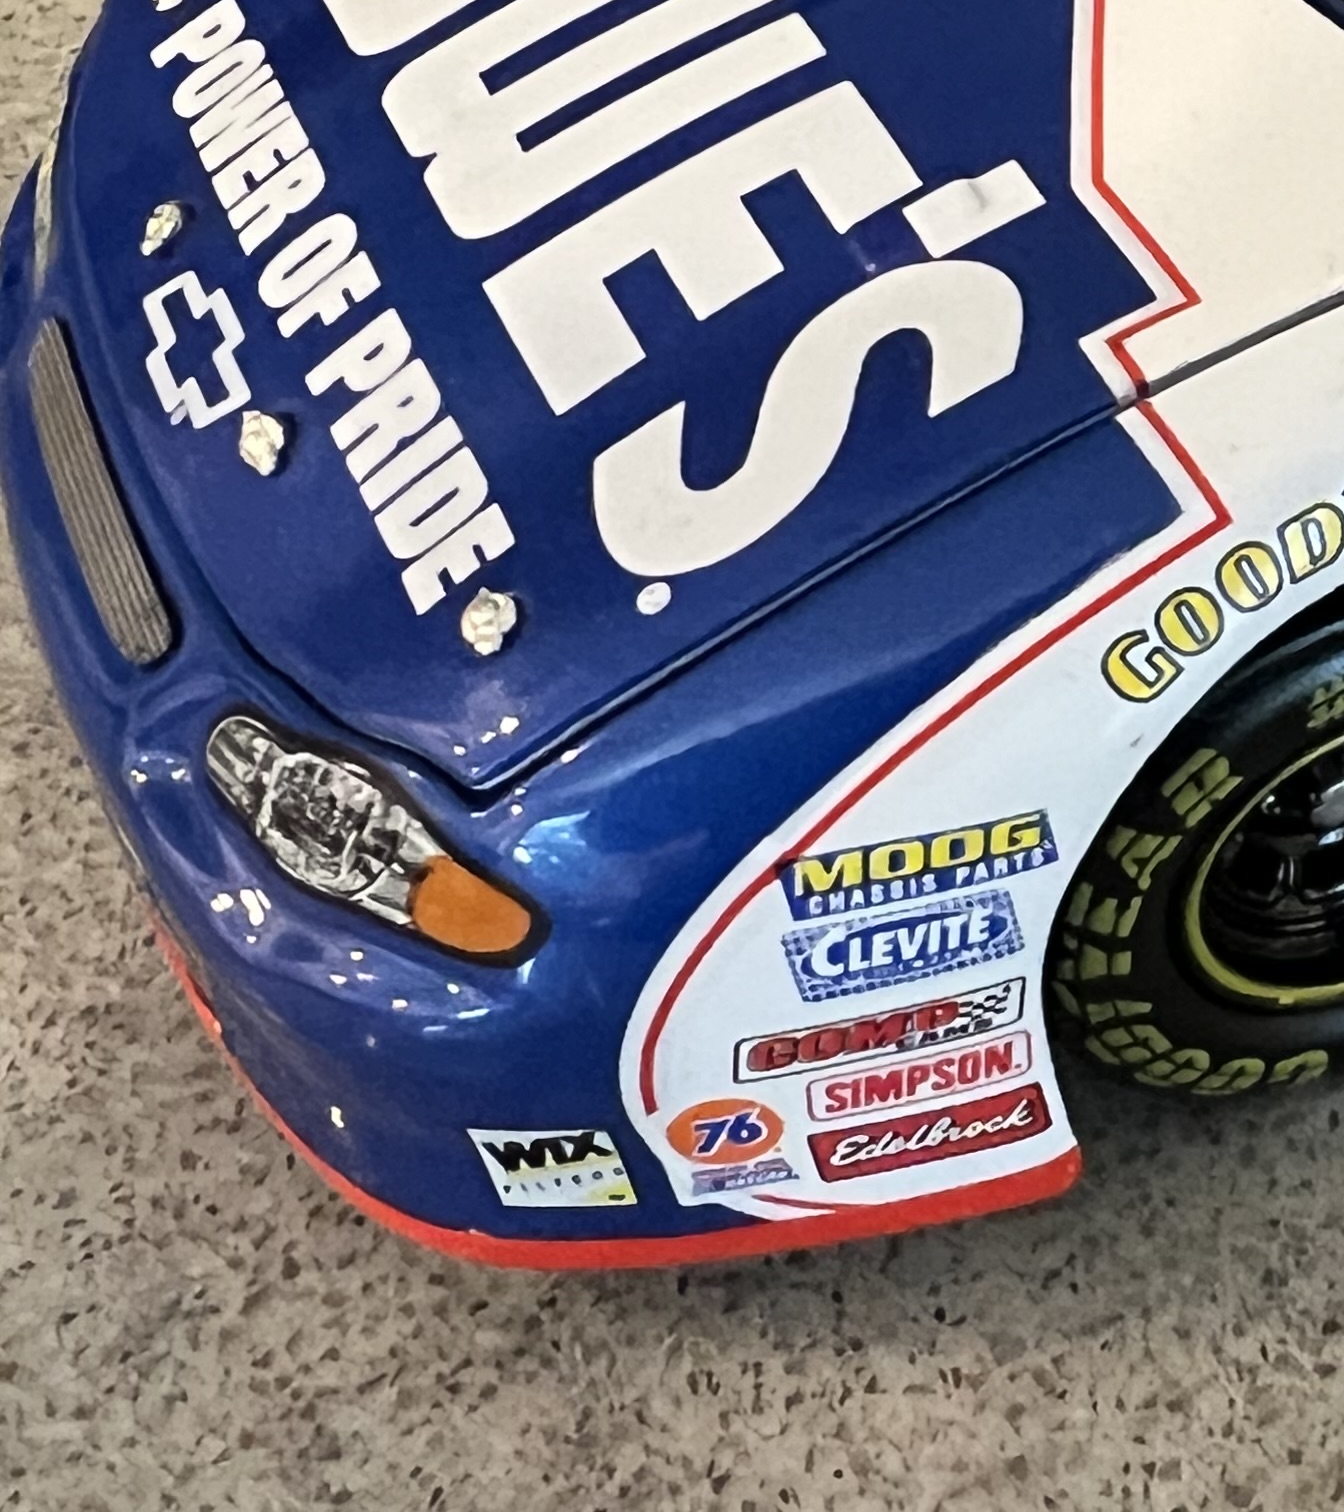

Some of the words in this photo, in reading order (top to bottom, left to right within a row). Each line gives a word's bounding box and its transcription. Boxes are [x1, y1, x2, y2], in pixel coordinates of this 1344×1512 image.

[257, 211, 381, 338] OF
[305, 308, 516, 615] PRIDE
[794, 814, 1041, 896] MOOG
[809, 873, 937, 916] CHASSIS
[956, 846, 1046, 887] PARTS
[811, 908, 992, 977] CLEVITE
[747, 1001, 960, 1071] COMP
[825, 1041, 1014, 1113] SIMPSON
[481, 1131, 612, 1171] WIX
[693, 1107, 767, 1156] 76
[829, 1099, 1034, 1166] Edelbrock
